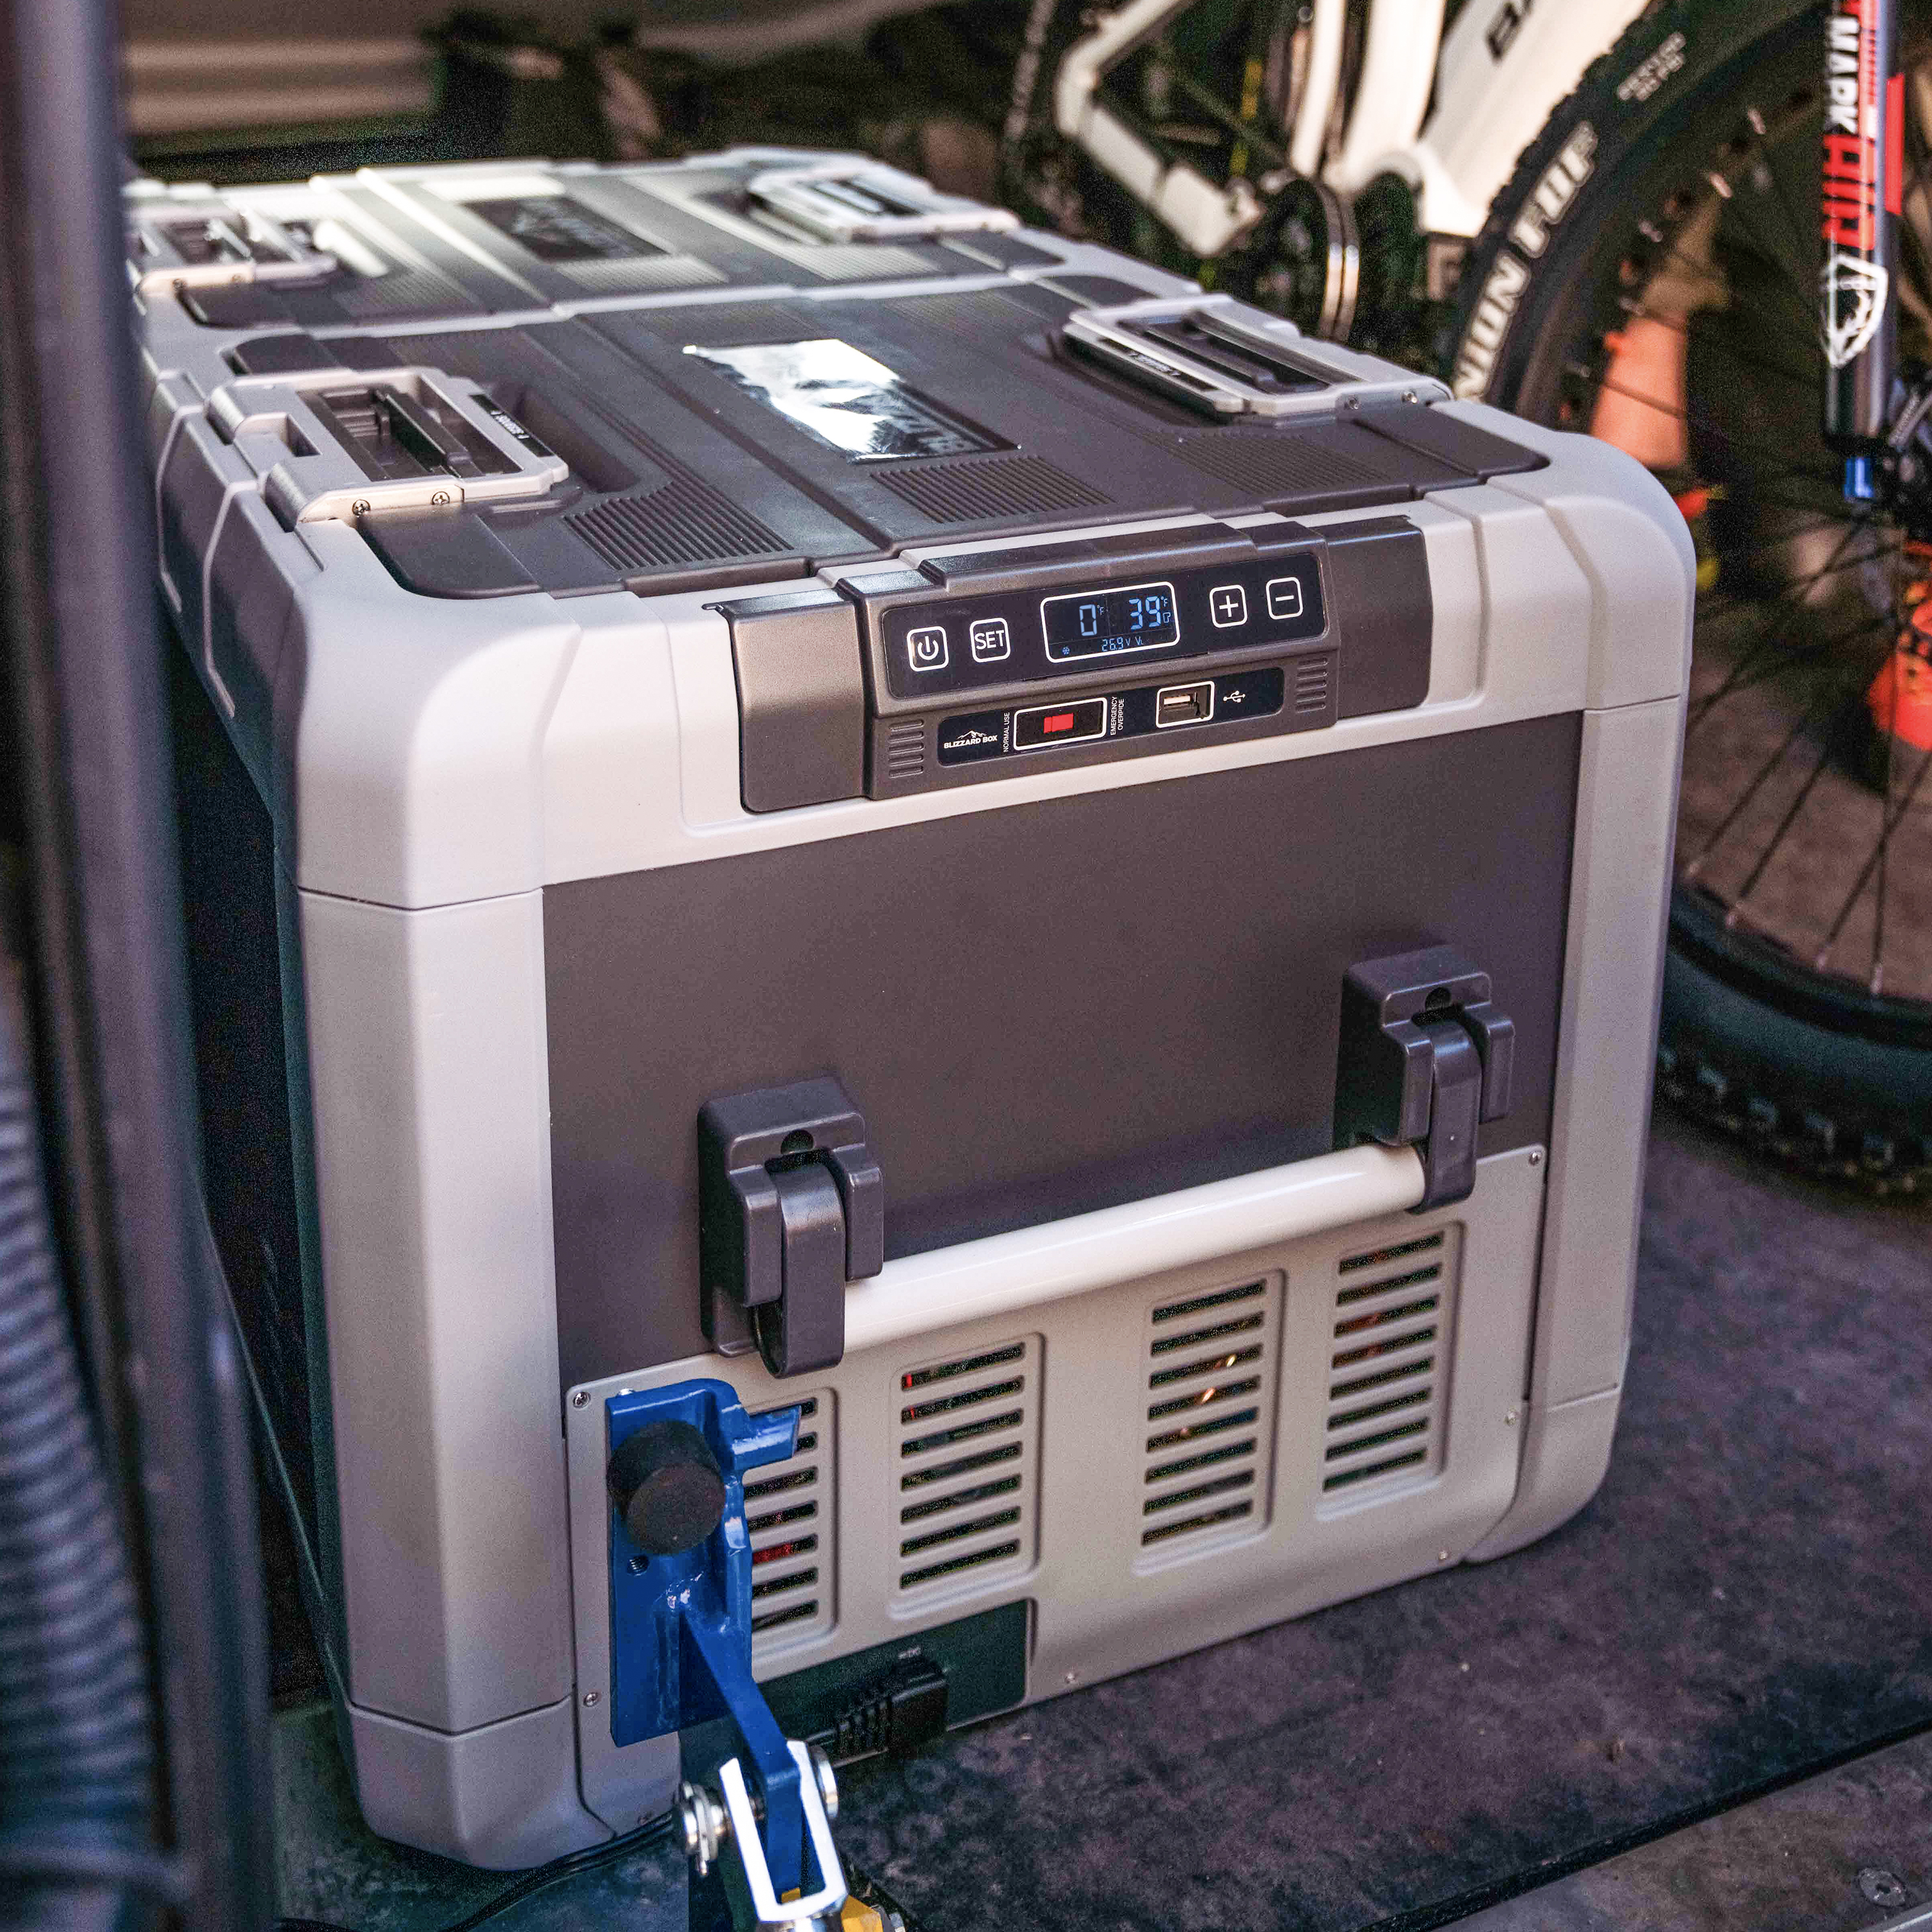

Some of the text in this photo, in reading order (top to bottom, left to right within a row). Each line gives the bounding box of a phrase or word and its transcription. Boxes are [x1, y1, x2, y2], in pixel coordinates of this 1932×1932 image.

[974, 629, 1005, 650] SET
[1110, 696, 1118, 735] EMERGENCY
[943, 735, 998, 749] BLIZZARD BOX
